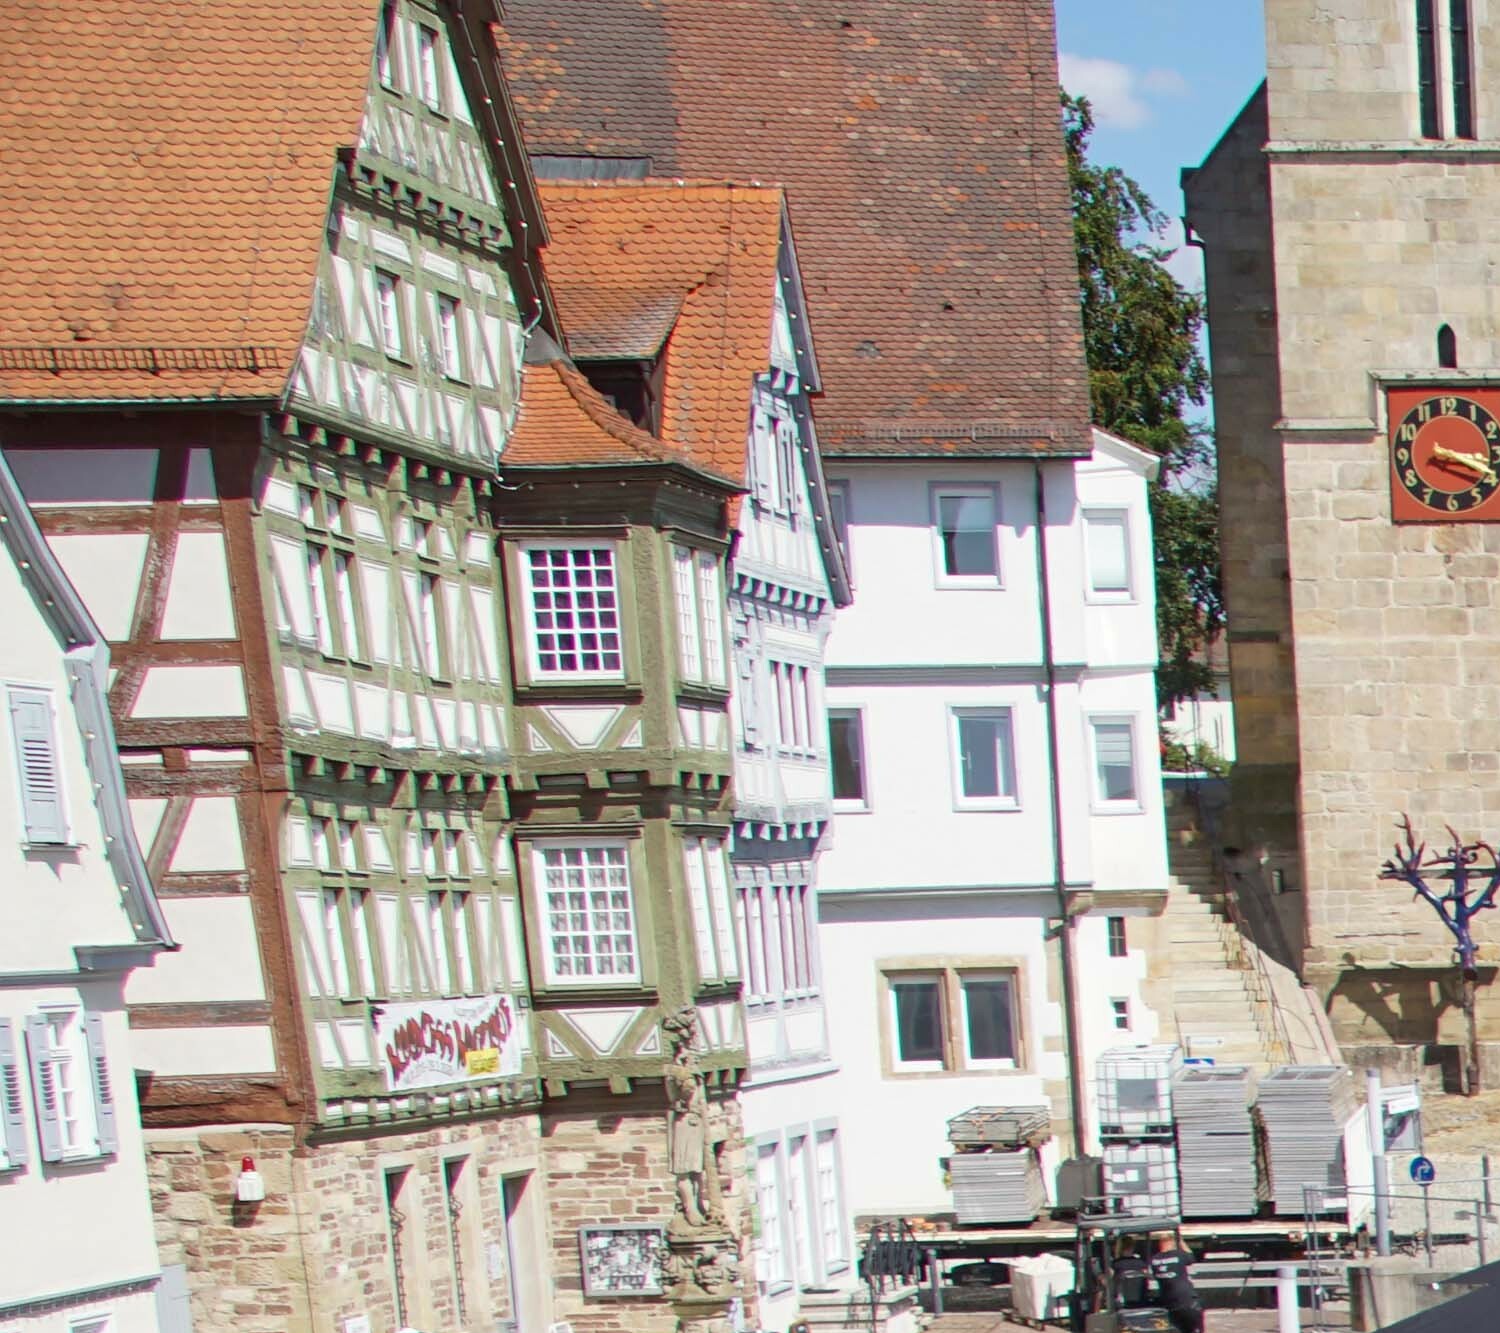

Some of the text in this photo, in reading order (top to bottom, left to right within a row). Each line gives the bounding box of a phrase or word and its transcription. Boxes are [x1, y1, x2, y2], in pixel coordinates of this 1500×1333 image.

[1418, 404, 1430, 421] 11
[1440, 398, 1457, 416] 12
[1469, 404, 1477, 421] 1
[1401, 423, 1417, 441] 10
[1485, 421, 1497, 439] 2
[1397, 447, 1409, 466] 9
[1405, 469, 1417, 487] 8
[1423, 488, 1434, 505] 7
[1446, 495, 1458, 511] 6
[1471, 488, 1482, 506] 5
